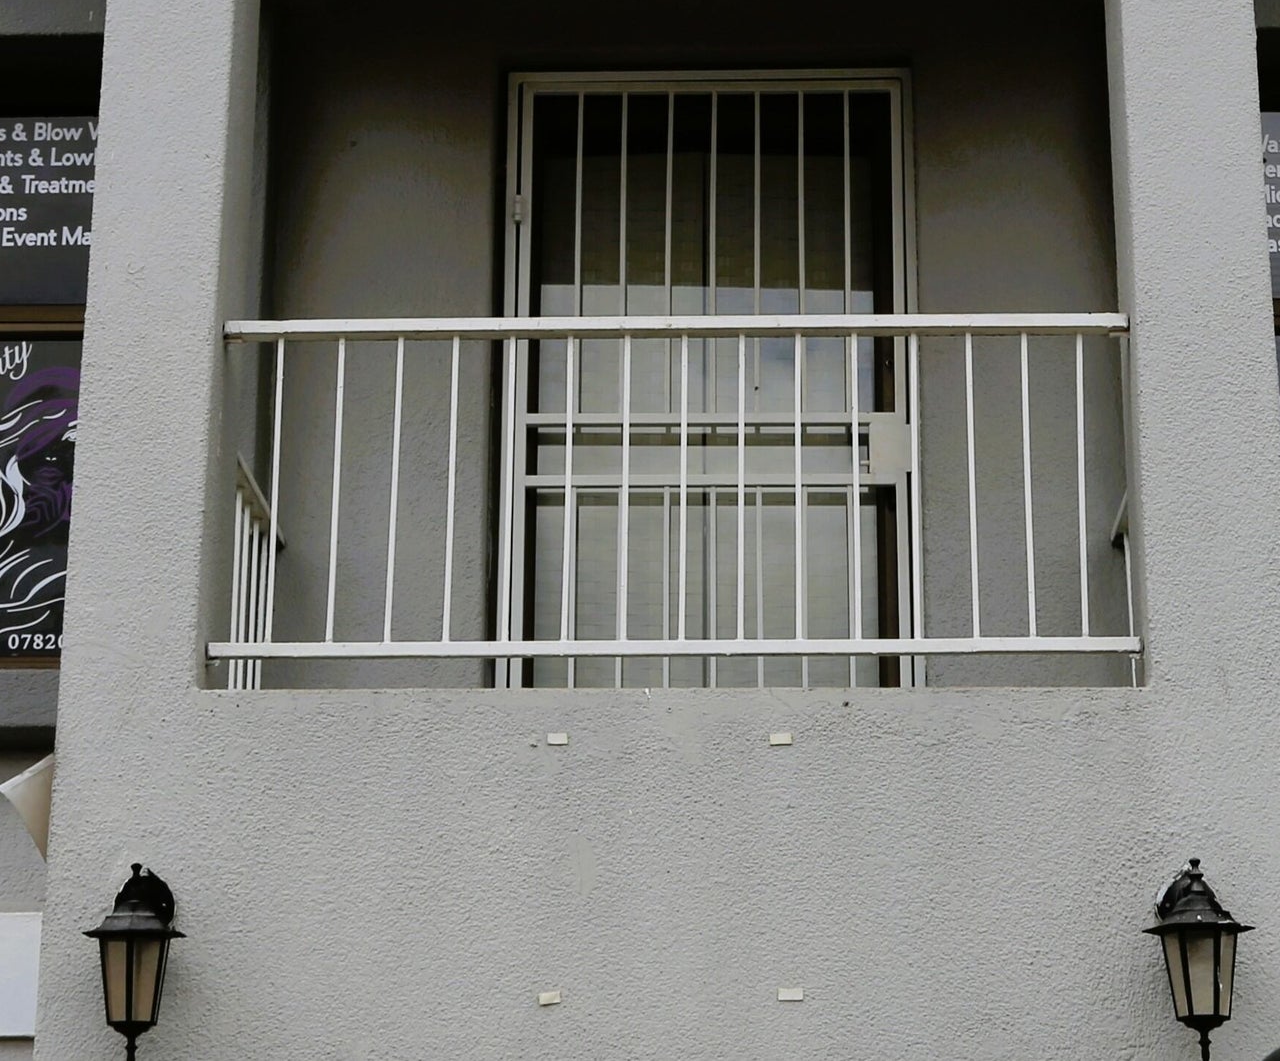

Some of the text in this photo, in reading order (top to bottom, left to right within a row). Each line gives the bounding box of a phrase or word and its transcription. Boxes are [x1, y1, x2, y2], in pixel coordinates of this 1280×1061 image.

[12, 123, 28, 141] &
[33, 122, 83, 141] Blow
[28, 148, 44, 167] &
[50, 147, 96, 166] Low
[21, 174, 95, 194] Treatme
[1, 227, 56, 246] Event
[61, 226, 92, 246] Ma
